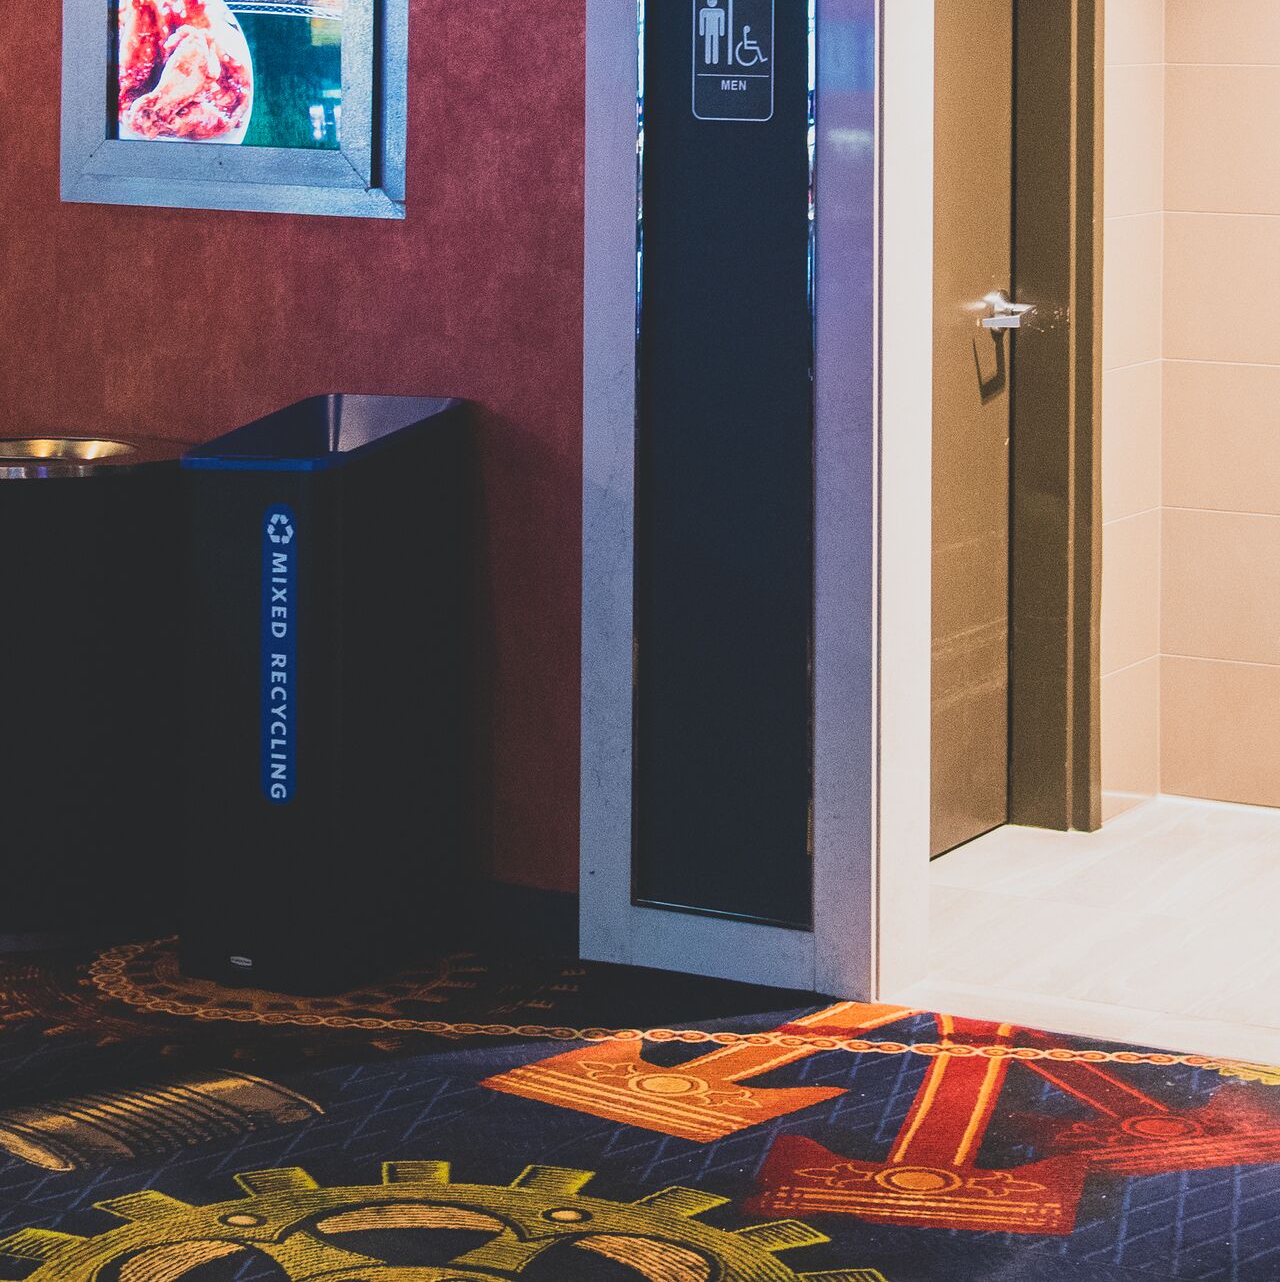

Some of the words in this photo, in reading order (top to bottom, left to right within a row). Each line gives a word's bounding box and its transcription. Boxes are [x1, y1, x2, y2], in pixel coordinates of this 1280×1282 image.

[721, 79, 747, 91] MEN
[271, 551, 288, 638] MIXED
[270, 652, 287, 800] RECYCLING
